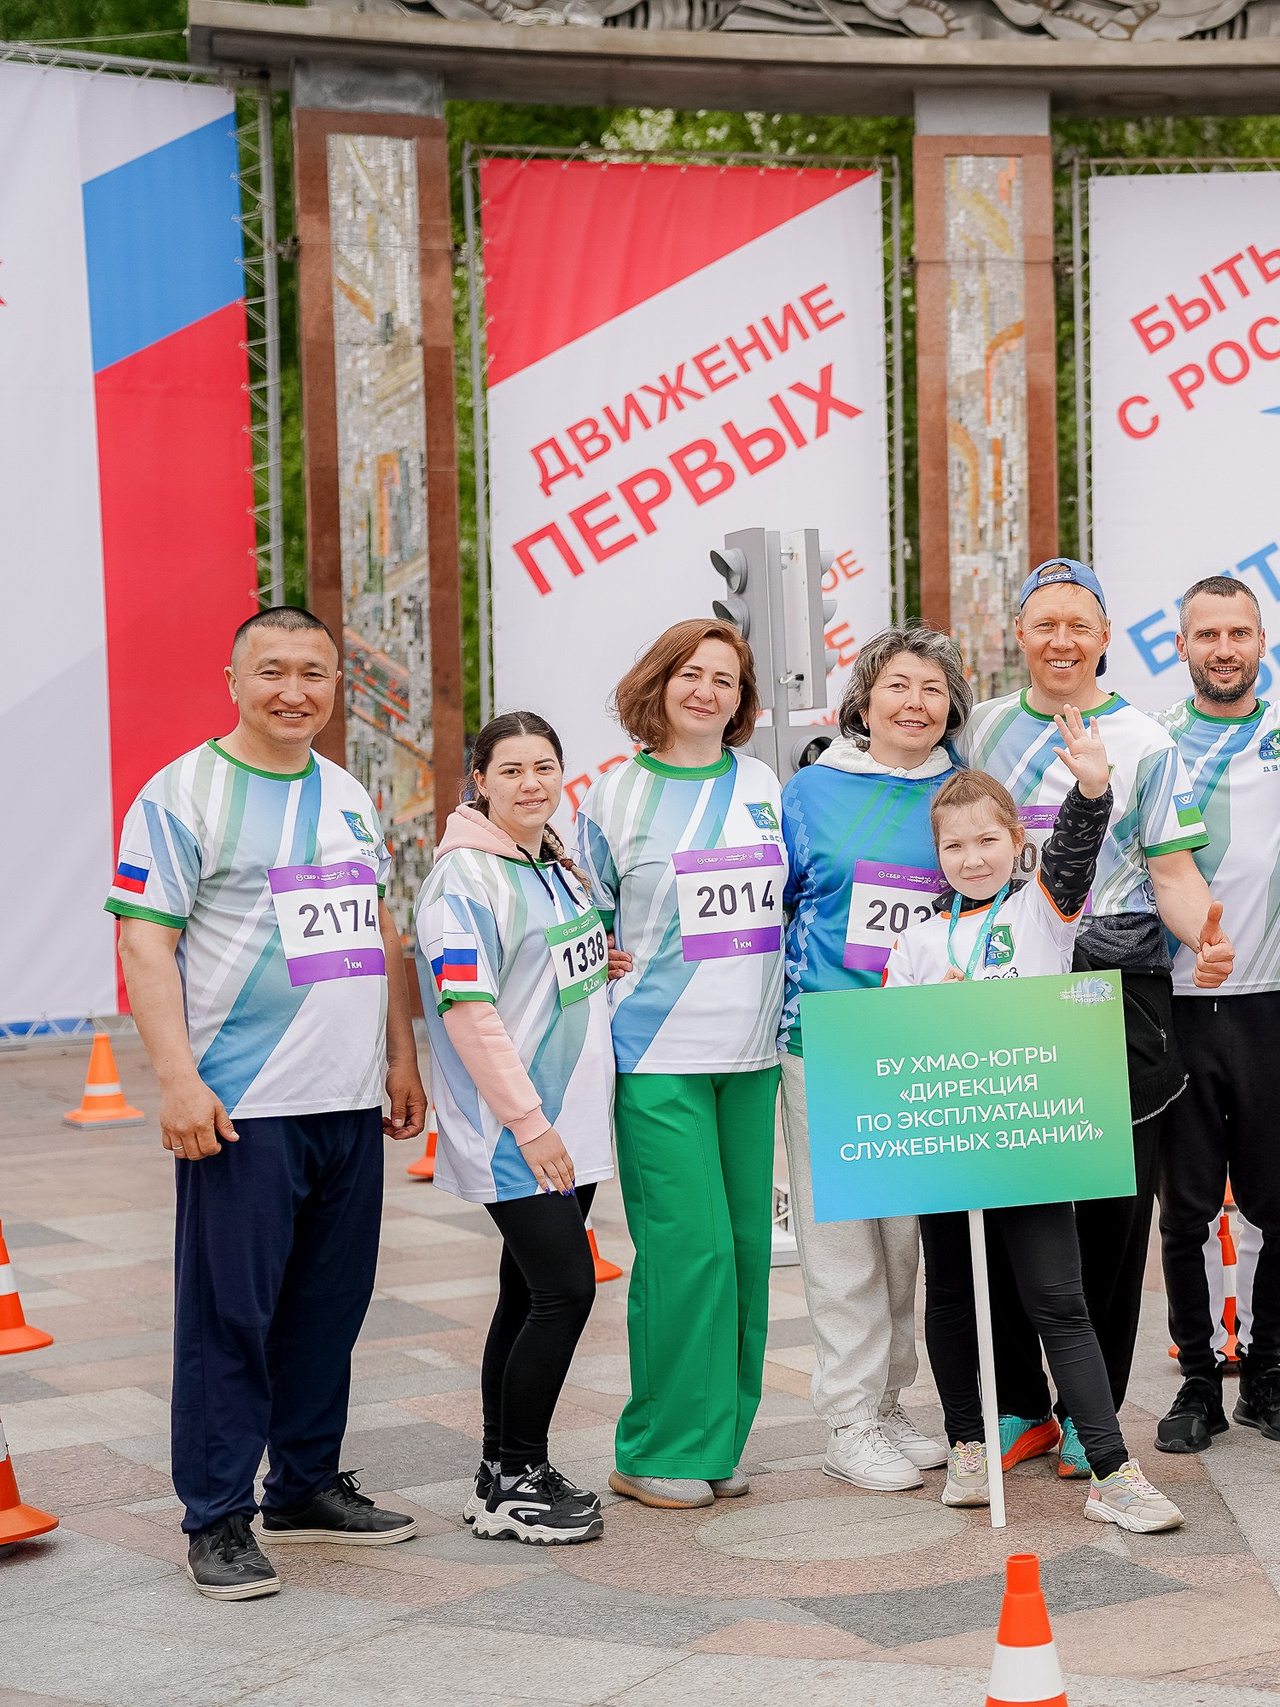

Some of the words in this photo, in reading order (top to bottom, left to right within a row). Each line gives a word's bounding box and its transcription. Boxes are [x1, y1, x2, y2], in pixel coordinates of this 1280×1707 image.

[531, 283, 845, 496] ДВИЖЕНИЕ
[1117, 396, 1159, 440] С
[512, 363, 864, 596] ПЕРВЫХ
[298, 899, 377, 938] 2174
[696, 880, 775, 918] 2014
[562, 931, 605, 978] 1338
[876, 1057, 905, 1077] БУ
[909, 1045, 1058, 1074] ХМАО-ЮГРЫ
[899, 1073, 1038, 1103] «ДИРЕКЦИЯ
[856, 1112, 892, 1133] ПО
[897, 1096, 1085, 1130] ЭКСПЛУАТАЦИИ
[839, 1131, 991, 1162] СЛУЖЕБНЫХ
[994, 1119, 1104, 1150] ЗДАНИЙ»
